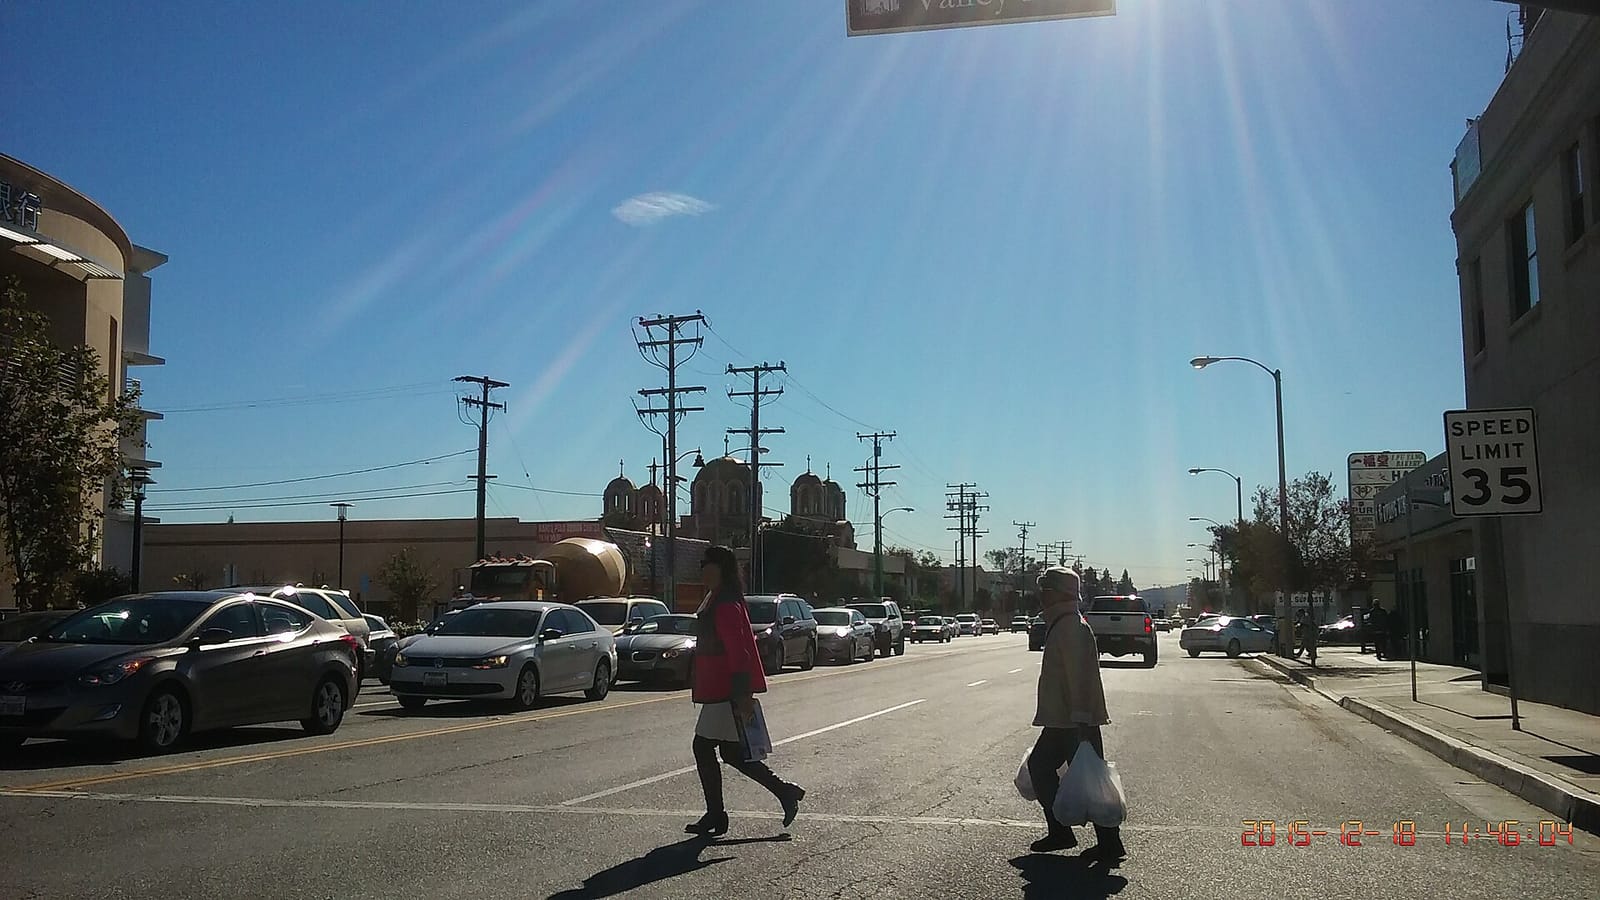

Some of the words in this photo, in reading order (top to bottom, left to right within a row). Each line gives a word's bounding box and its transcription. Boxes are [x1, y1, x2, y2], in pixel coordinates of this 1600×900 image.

[1451, 418, 1530, 437] SPEED
[1460, 442, 1525, 461] LIMIT
[1460, 466, 1532, 506] 35
